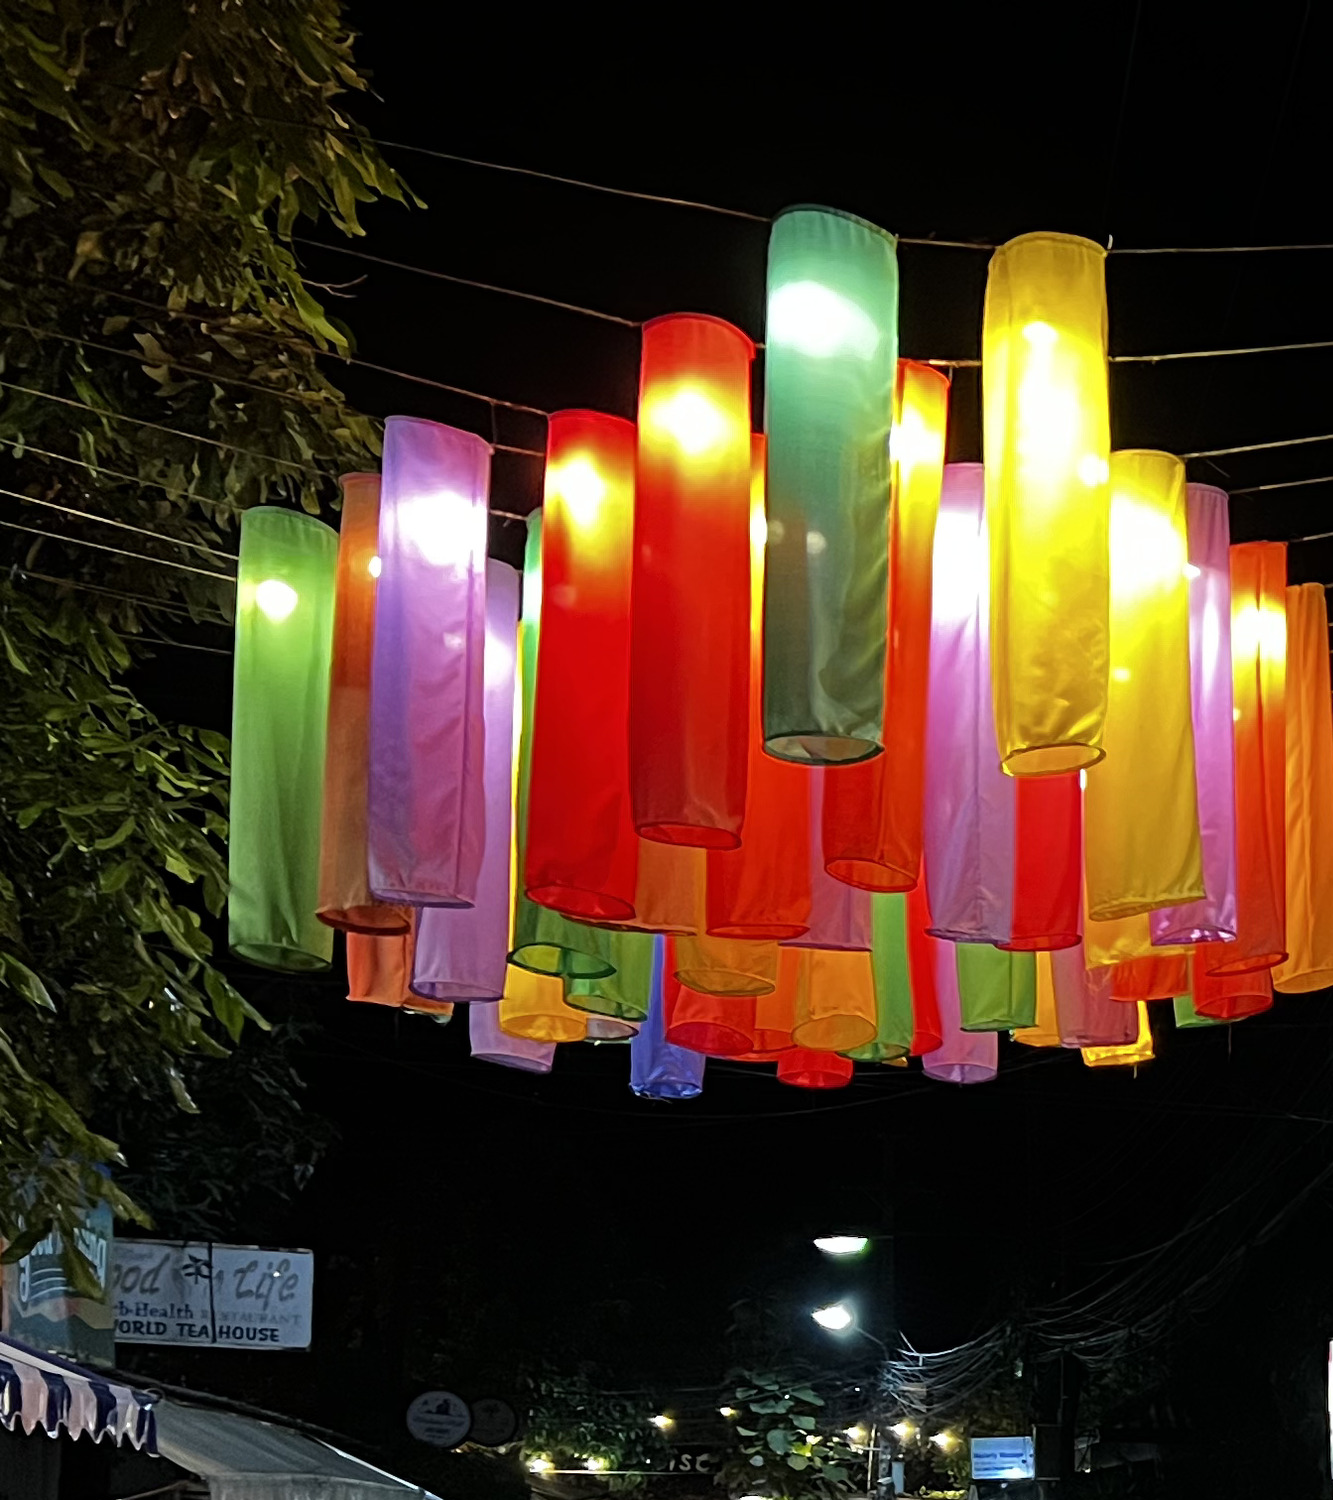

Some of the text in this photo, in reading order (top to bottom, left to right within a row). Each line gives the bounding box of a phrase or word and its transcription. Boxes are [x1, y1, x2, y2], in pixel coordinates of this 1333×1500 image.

[233, 1257, 300, 1312] Life
[176, 1322, 209, 1340] TEA
[218, 1325, 281, 1343] HOUSE
